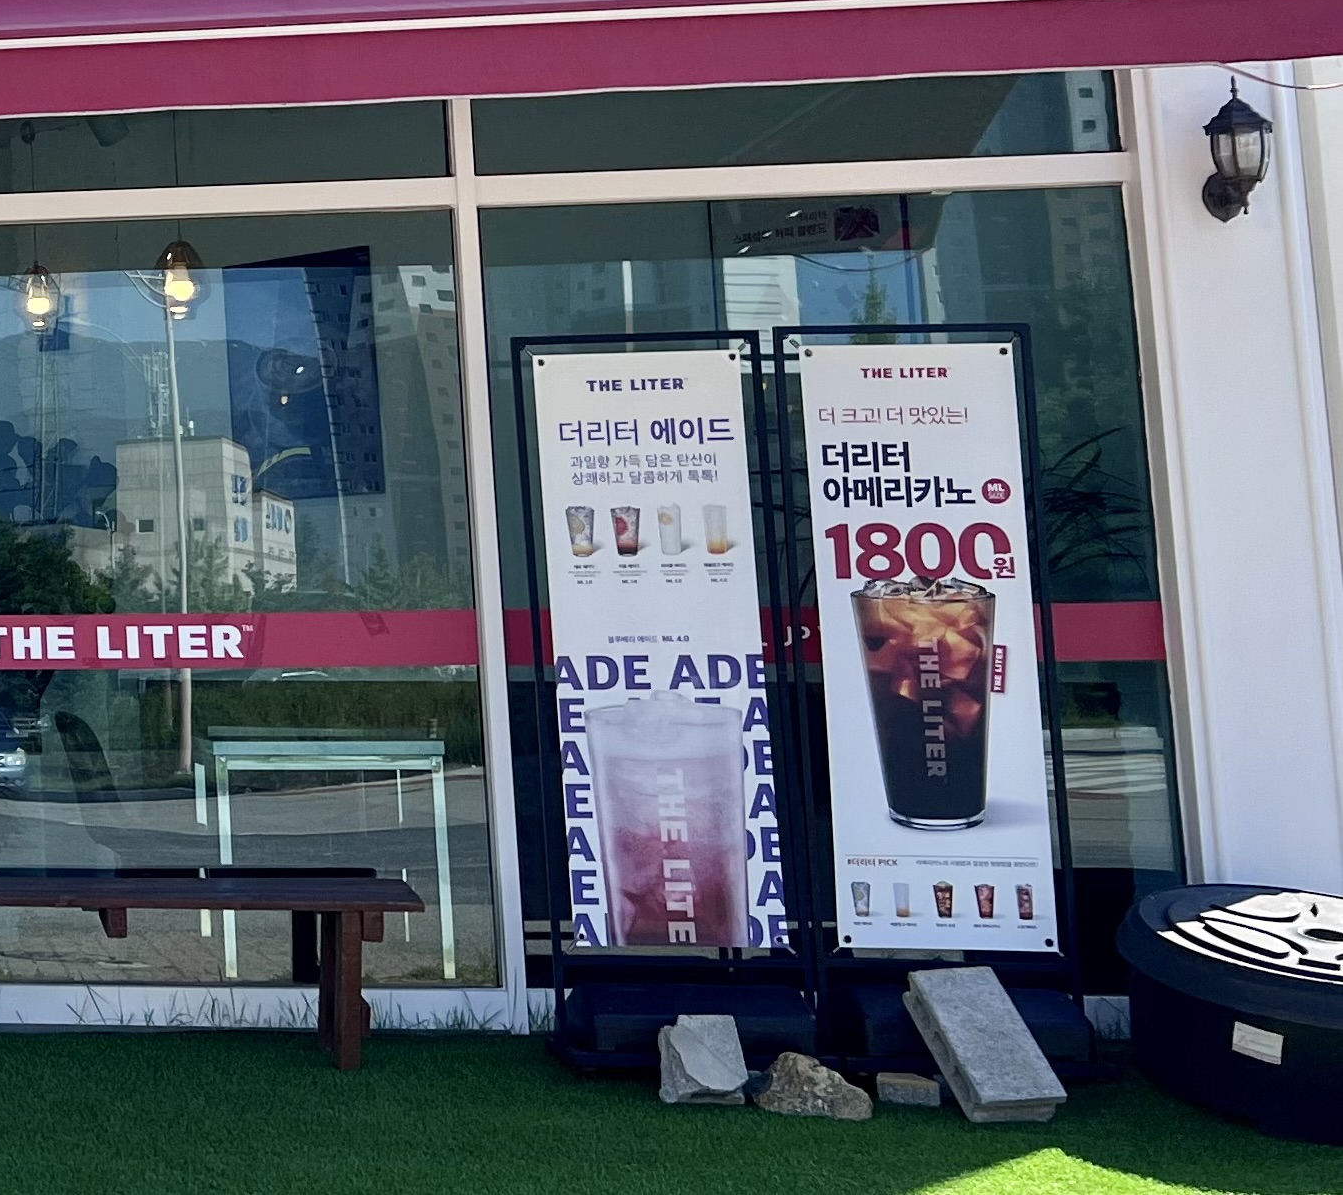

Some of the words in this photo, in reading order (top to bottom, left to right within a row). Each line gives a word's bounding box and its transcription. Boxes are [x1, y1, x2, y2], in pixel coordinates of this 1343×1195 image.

[586, 378, 623, 392] THE
[630, 377, 685, 391] LITER
[861, 368, 893, 379] THE
[899, 367, 948, 378] LITER
[818, 407, 836, 425] 더
[841, 407, 881, 424] 크고!
[887, 406, 904, 424] 더
[909, 405, 969, 424] 맛있는!
[559, 418, 640, 447] 더리터
[650, 416, 735, 445] 에이드
[676, 452, 717, 467] 탄산이
[821, 442, 911, 473] 더리터
[823, 476, 976, 507] 아메리카노
[987, 482, 1005, 491] ML
[96, 625, 244, 659] LITER
[556, 655, 651, 691] ADE
[917, 637, 942, 689] THE
[922, 699, 948, 779] LITER
[656, 768, 688, 843] THE
